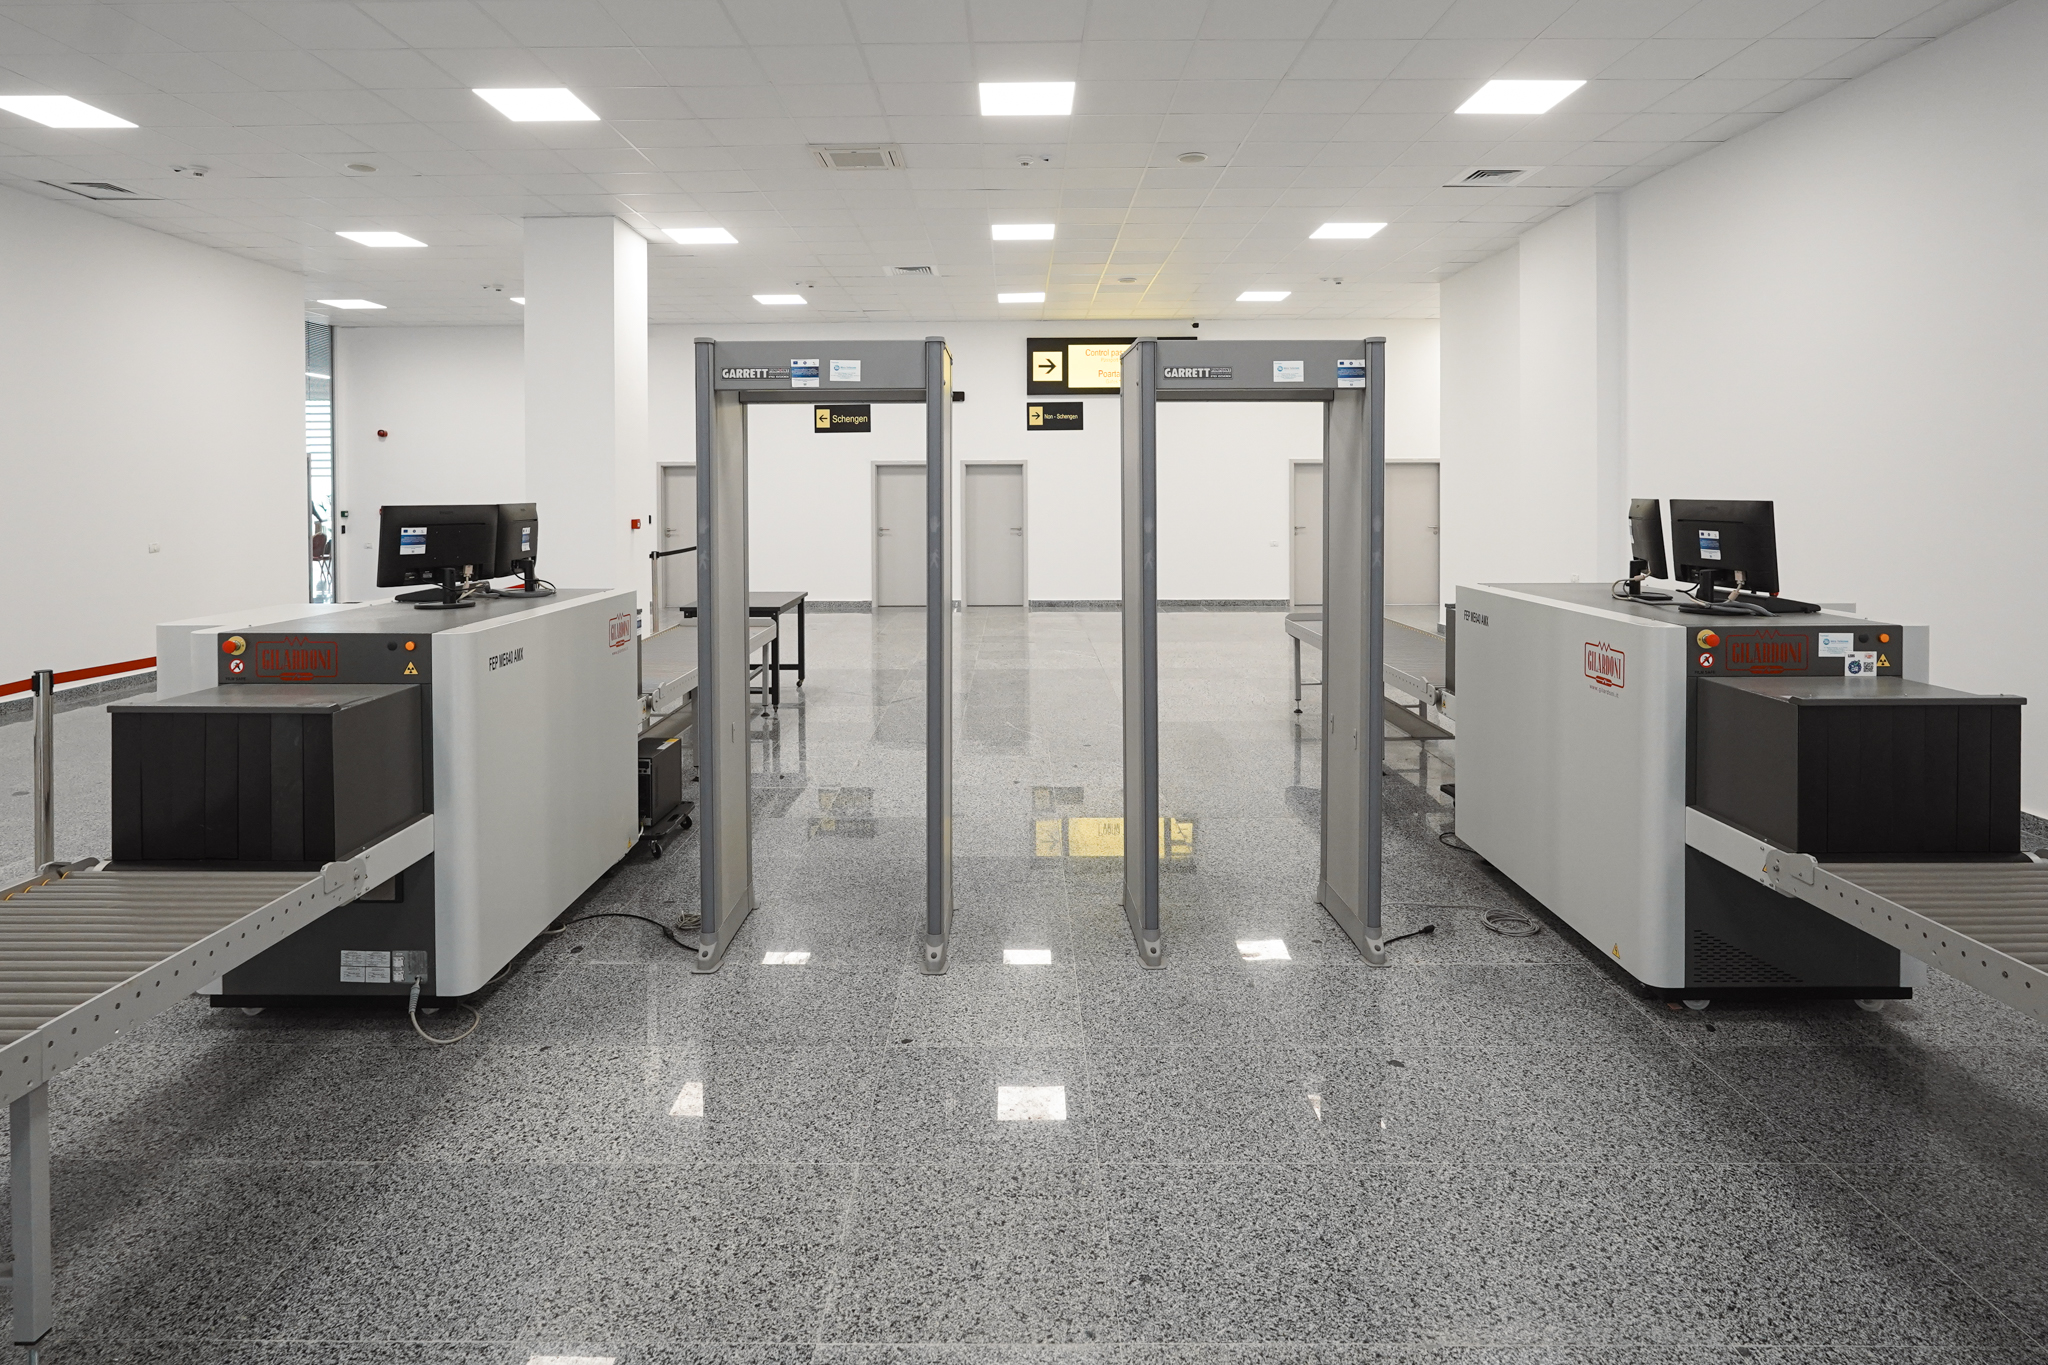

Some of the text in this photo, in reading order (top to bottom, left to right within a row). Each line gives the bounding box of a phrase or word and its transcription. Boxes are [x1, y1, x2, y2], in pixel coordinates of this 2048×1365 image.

[1085, 348, 1109, 357] Control
[722, 368, 768, 378] GARRETT
[1164, 368, 1210, 377] GARRETT
[832, 414, 868, 425] Schengen
[262, 649, 331, 671] GILARDONI
[489, 655, 499, 671] FEP
[514, 647, 524, 663] AMX
[1732, 643, 1802, 664] GILARDONI
[1587, 650, 1621, 680] GILARDONI
